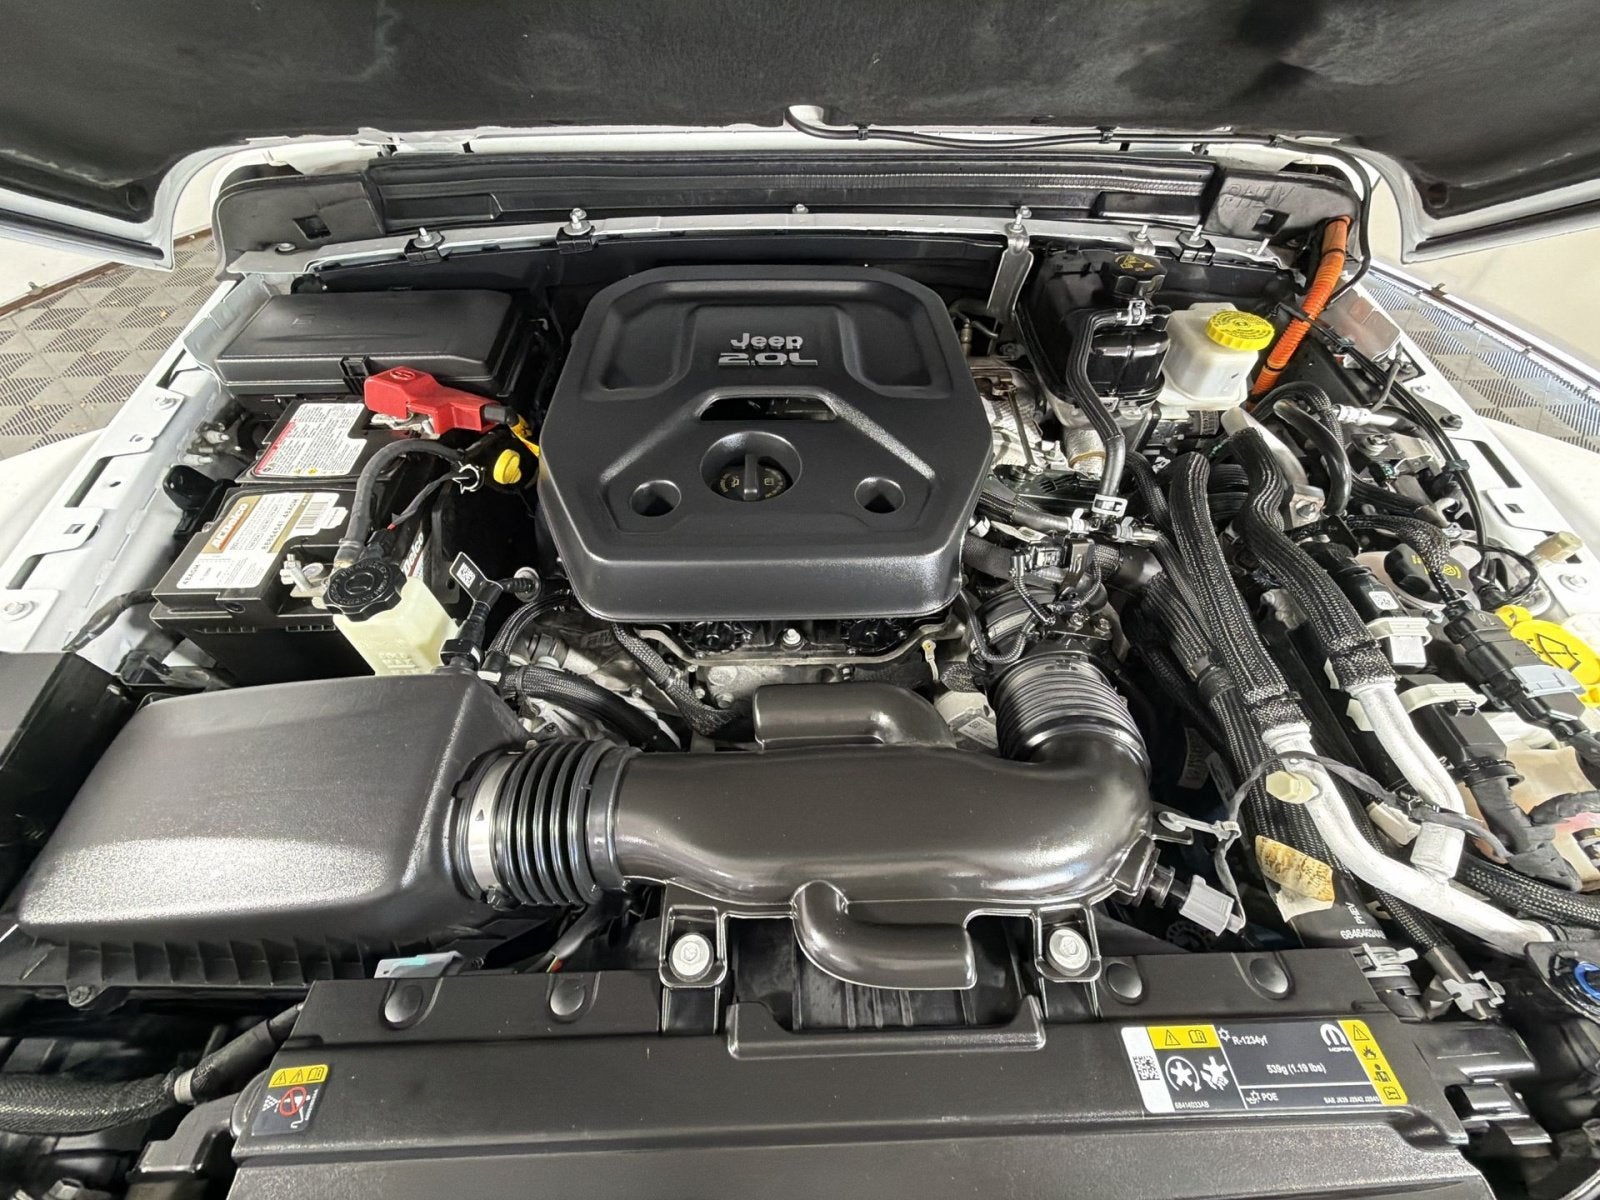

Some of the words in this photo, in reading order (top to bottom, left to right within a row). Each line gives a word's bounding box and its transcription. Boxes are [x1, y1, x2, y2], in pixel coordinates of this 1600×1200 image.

[730, 333, 803, 349] Jeep
[718, 352, 818, 366] 2.0L
[1345, 902, 1366, 925] PHEV
[1232, 1034, 1268, 1047] R-1234yf
[1266, 1063, 1289, 1075] 539g
[1288, 1063, 1307, 1075] (1.19
[1309, 1062, 1327, 1074] lbs)
[1261, 1092, 1279, 1101] POE
